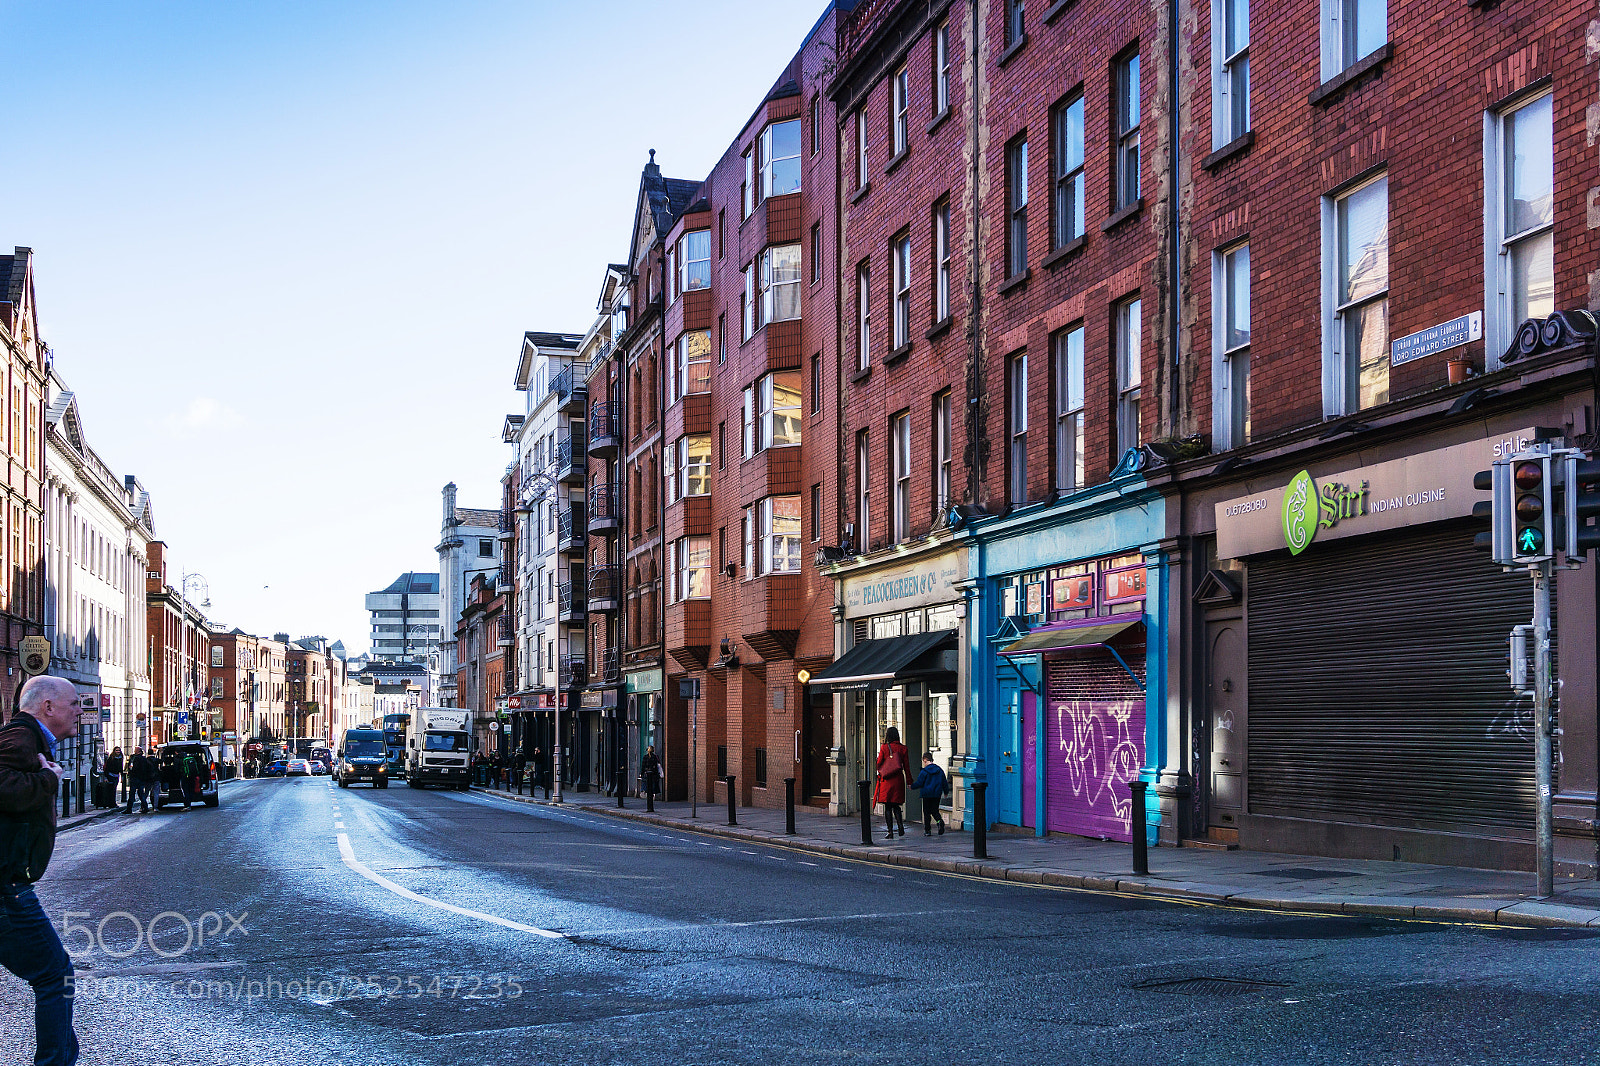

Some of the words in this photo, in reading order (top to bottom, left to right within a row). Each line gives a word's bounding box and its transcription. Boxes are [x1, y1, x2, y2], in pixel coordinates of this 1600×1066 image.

[1413, 337, 1421, 345] AN
[1473, 320, 1478, 332] 2
[1393, 351, 1410, 363] LORD
[1411, 340, 1440, 356] EDWARD
[1442, 330, 1469, 346] STREET
[1319, 480, 1365, 528] Siri
[1370, 497, 1403, 513] INDIAN
[1405, 488, 1445, 506] CUISINE
[863, 575, 919, 605] PEACOCKGREEN
[920, 574, 927, 594] &
